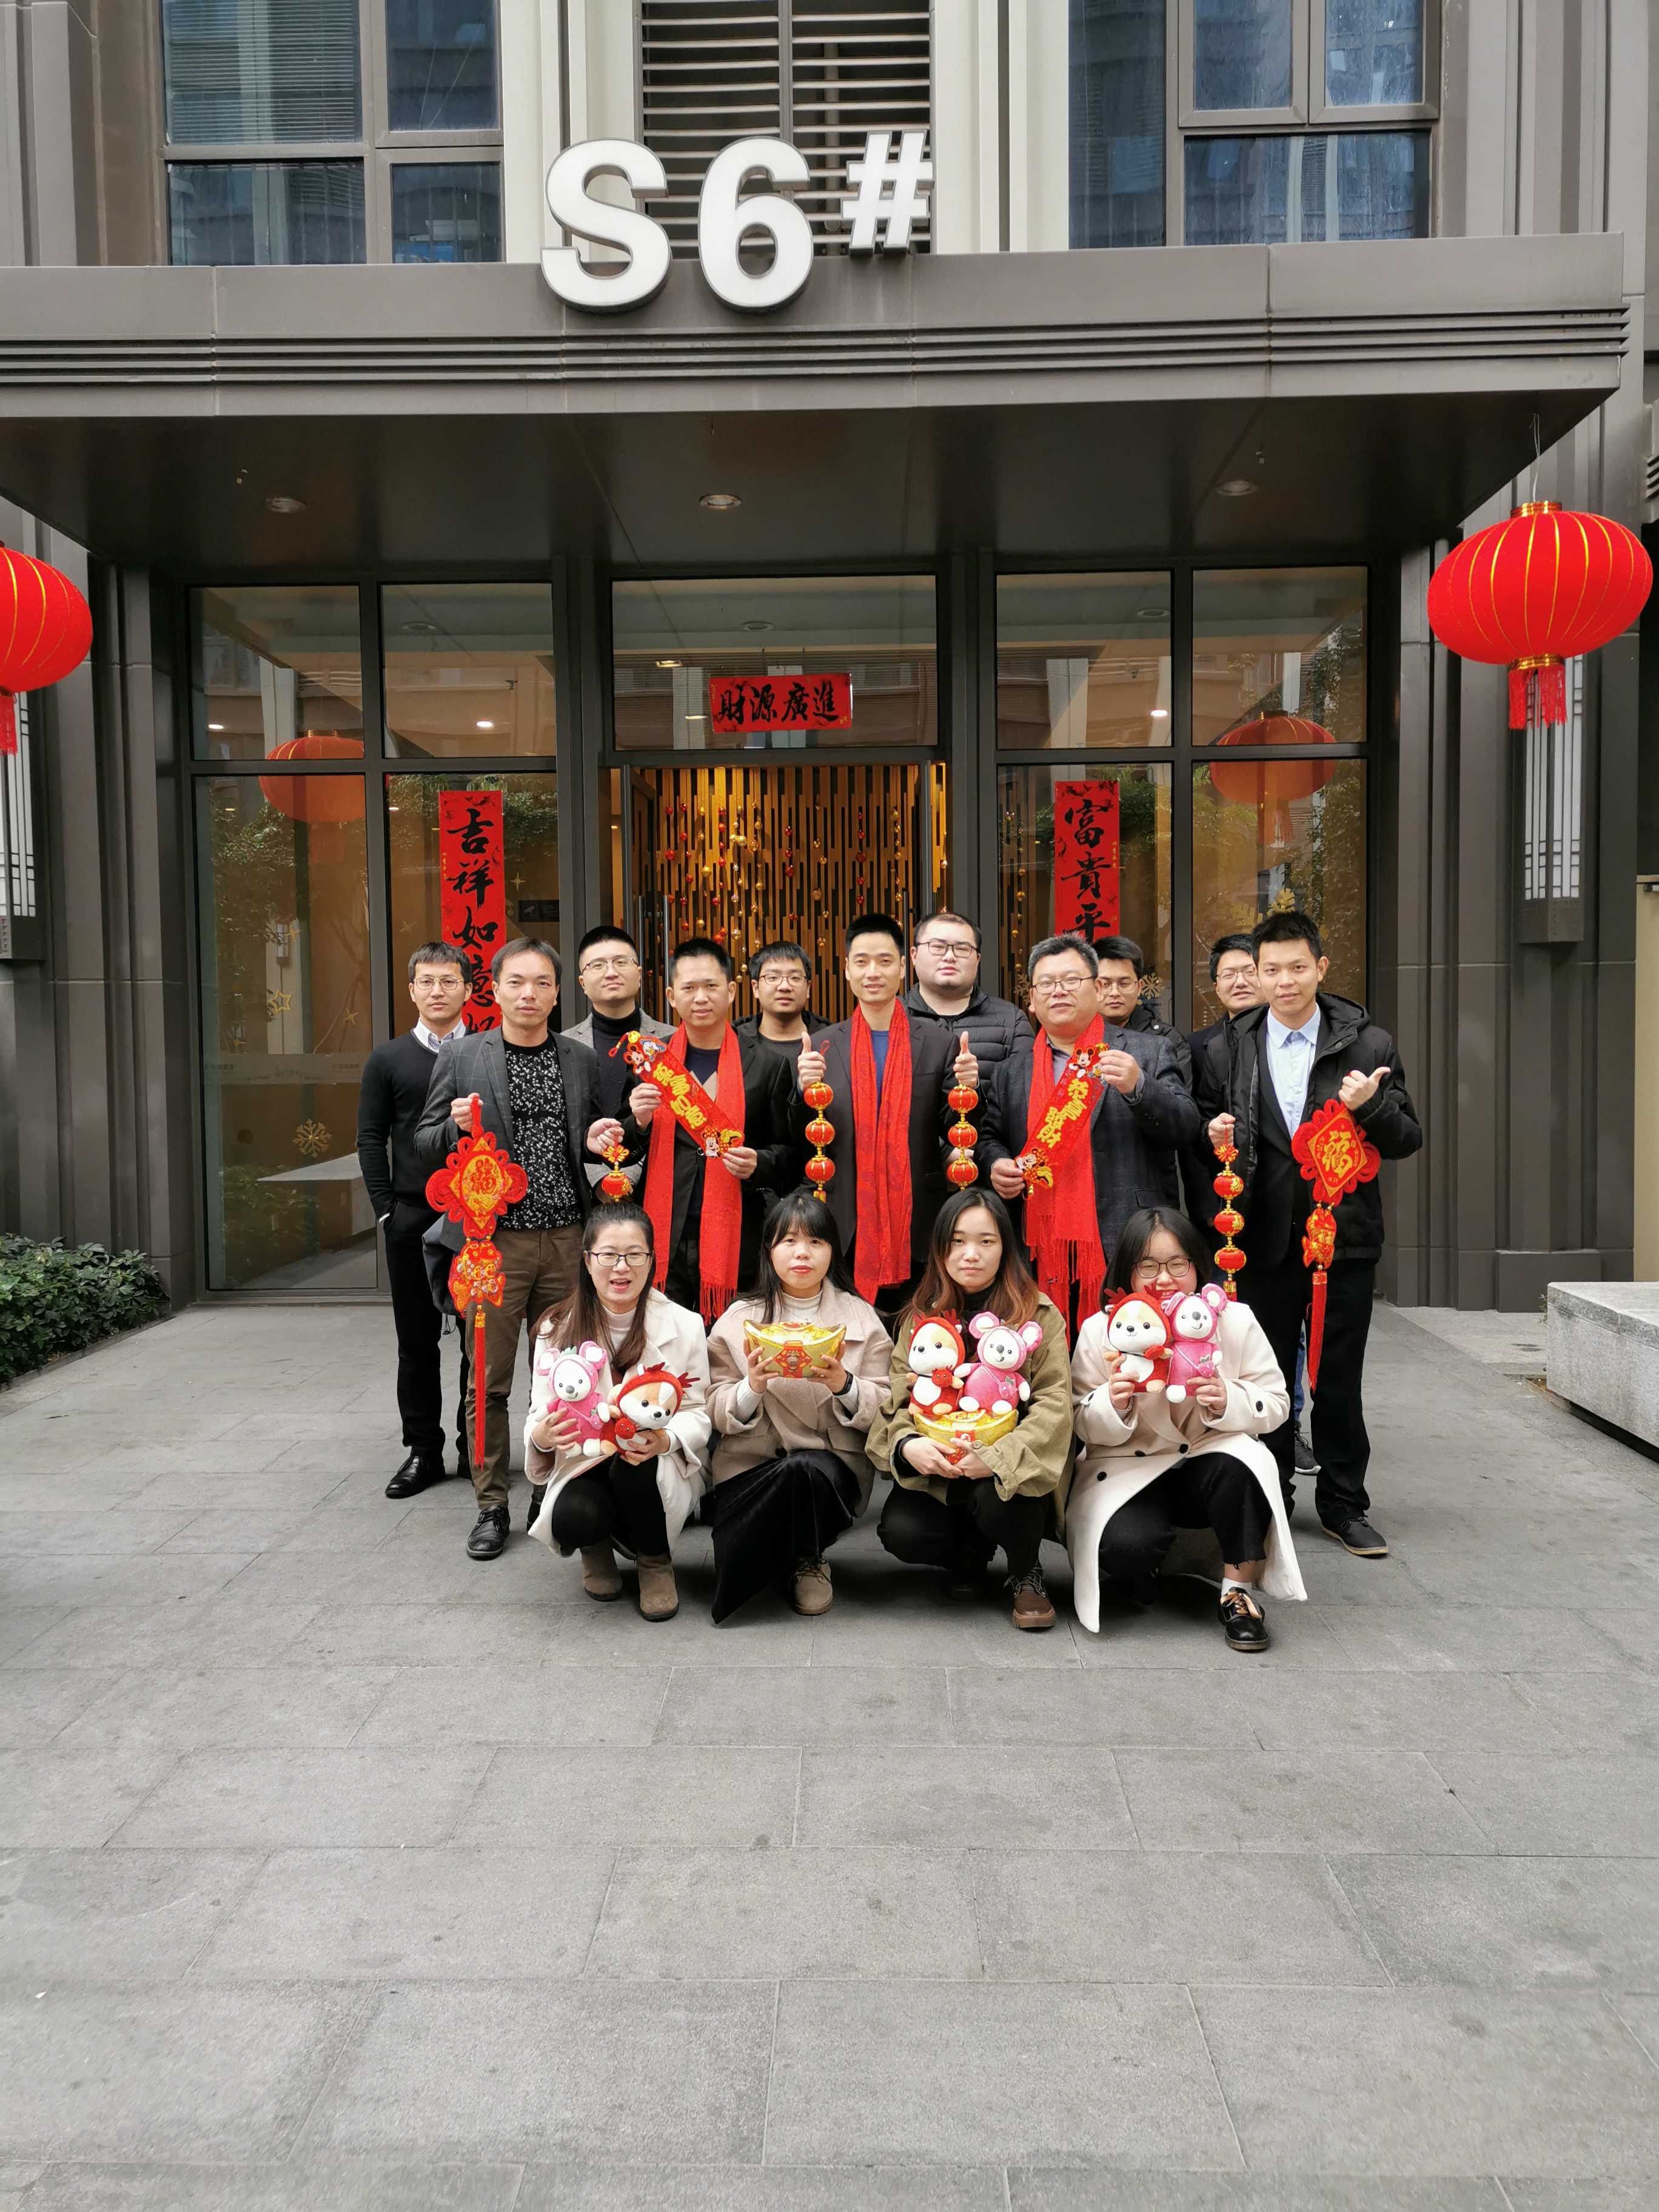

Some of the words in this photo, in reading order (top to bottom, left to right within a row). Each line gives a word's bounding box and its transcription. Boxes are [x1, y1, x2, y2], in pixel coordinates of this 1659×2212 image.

[540, 131, 934, 313] S6#
[717, 680, 840, 725] 財源廣進
[1036, 1078, 1089, 1149] 恭喜發財
[1321, 1130, 1353, 1179] 福
